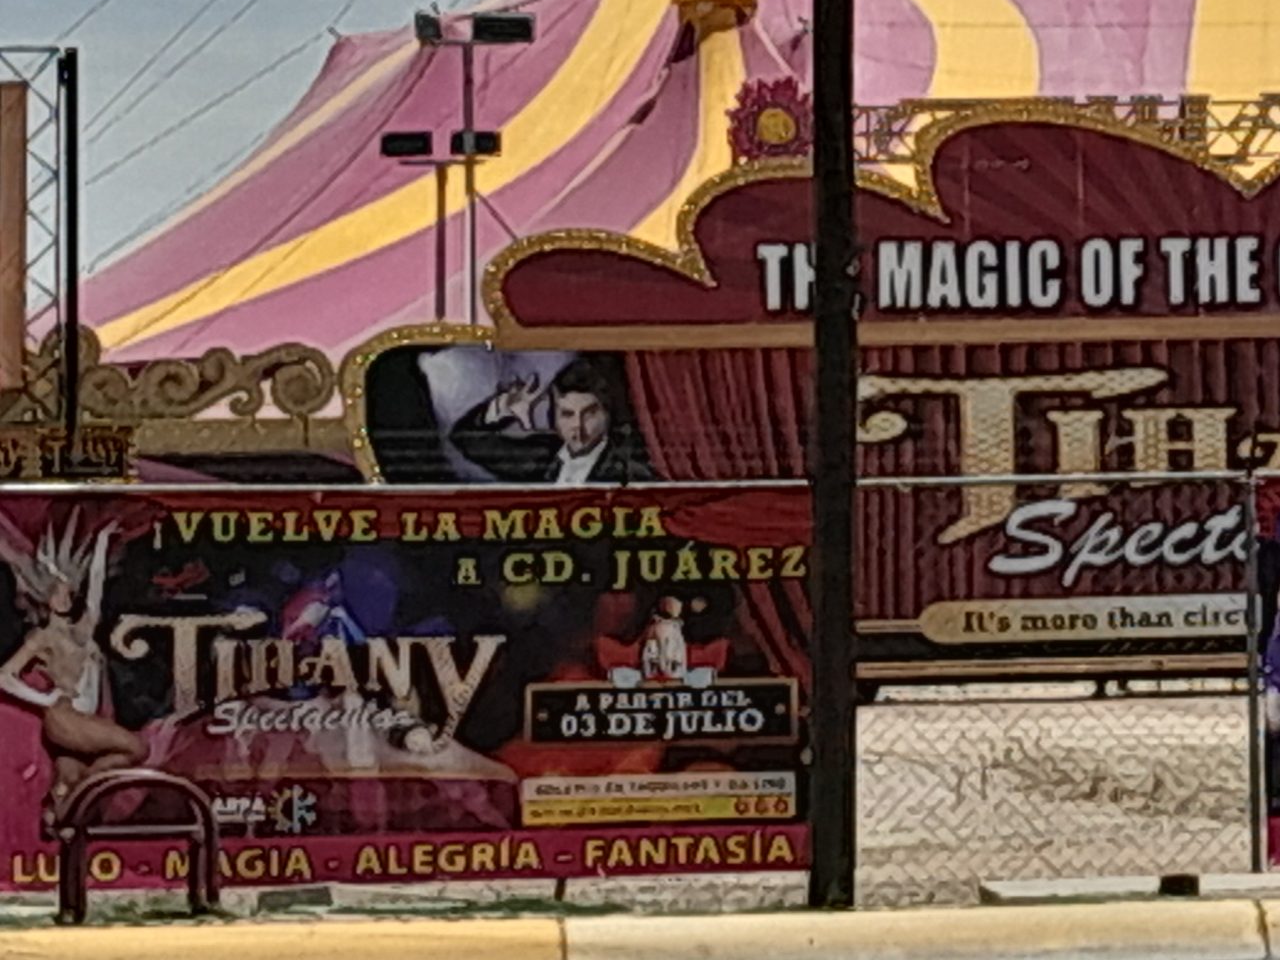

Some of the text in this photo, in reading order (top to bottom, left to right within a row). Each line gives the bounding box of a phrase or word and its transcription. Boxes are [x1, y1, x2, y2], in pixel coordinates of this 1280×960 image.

[878, 239, 1063, 310] MAGIC
[1080, 238, 1144, 307] OF
[1161, 236, 1260, 305] THE
[401, 511, 461, 542] LA
[483, 505, 666, 541] MAGIA
[457, 558, 481, 585] A
[503, 552, 592, 583] CD.
[962, 611, 1012, 633] It's
[1021, 612, 1098, 632] more
[1108, 606, 1173, 630] than
[575, 692, 590, 711] A
[702, 690, 751, 708] DEL
[561, 707, 765, 740] 03 DE JULIO
[12, 848, 122, 883] LUO
[356, 835, 540, 876] ALEGRÍA
[585, 829, 794, 870] FANTASÍA
